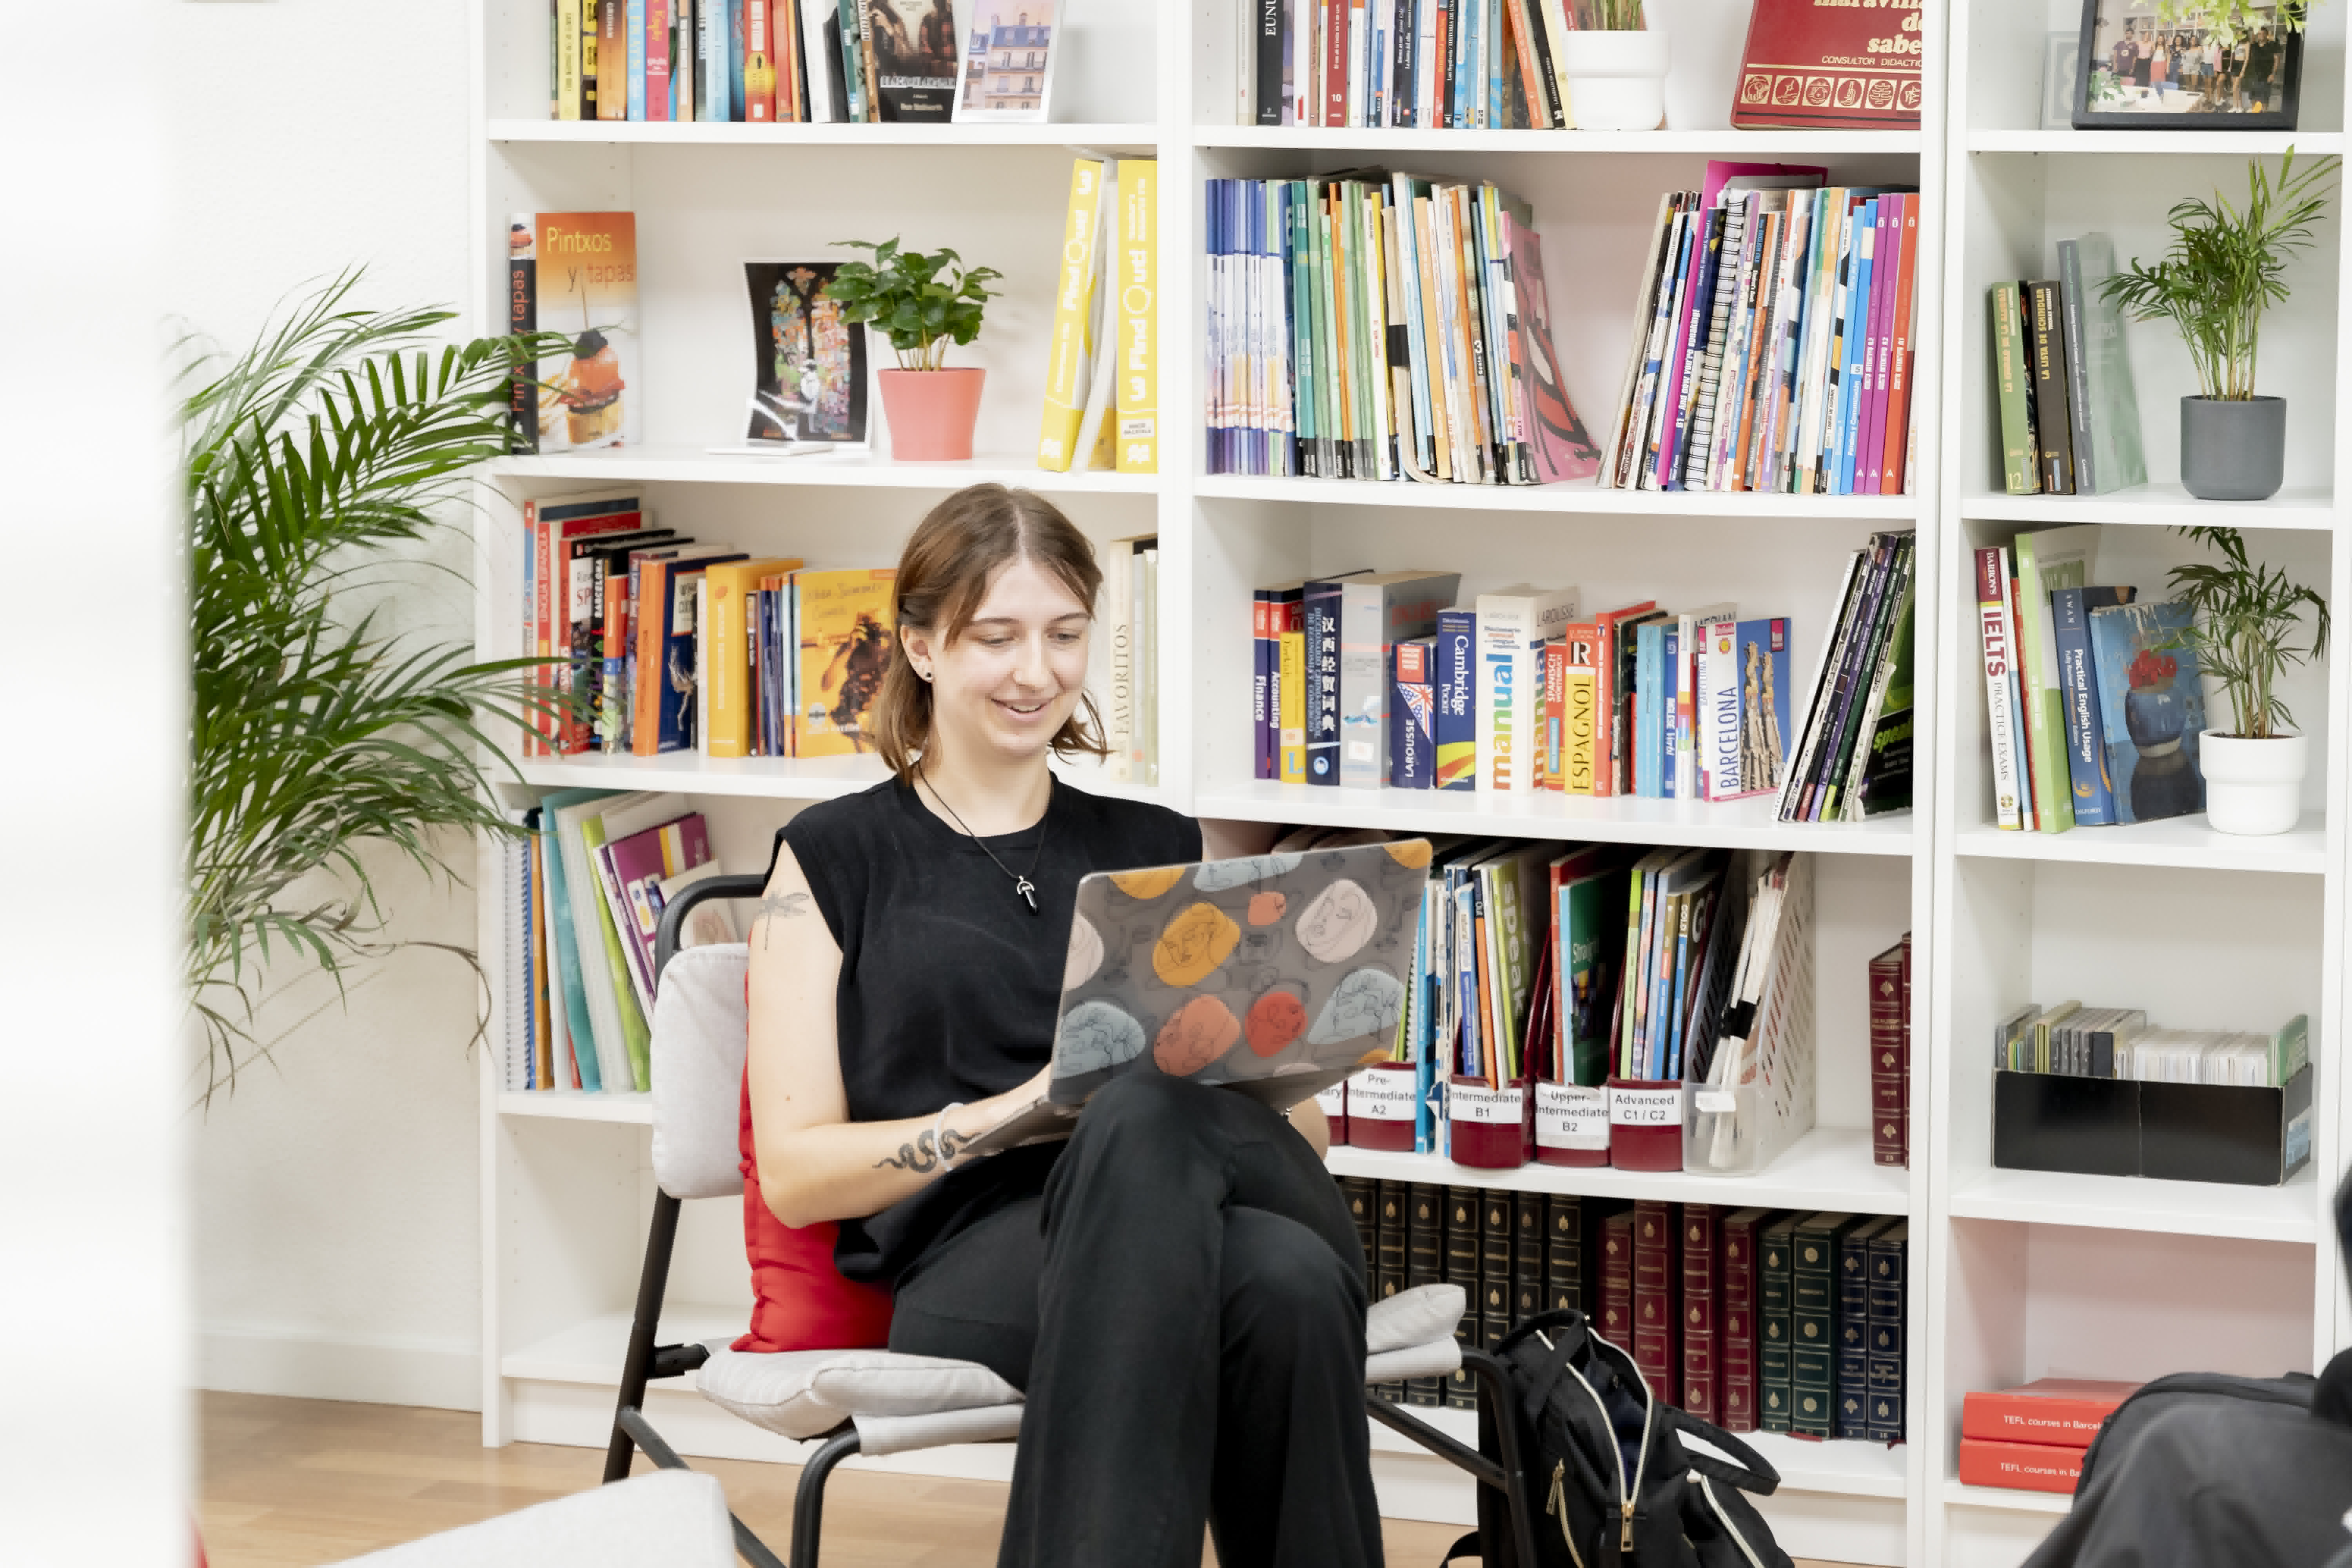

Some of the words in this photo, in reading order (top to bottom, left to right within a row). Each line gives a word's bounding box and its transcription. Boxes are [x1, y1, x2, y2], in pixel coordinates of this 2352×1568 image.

[1867, 34, 1922, 55] sabe
[1821, 56, 1875, 65] CONSULTOR
[546, 227, 612, 253] Pintxos
[568, 267, 577, 292] y
[587, 263, 634, 289] tapas
[512, 269, 530, 321] tapas
[2036, 288, 2047, 331] SCHINDLER
[1686, 309, 1700, 346] speaking!
[2040, 333, 2047, 343] DE
[1683, 348, 1694, 374] you're
[2040, 346, 2049, 367] LISTA
[1681, 376, 1690, 394] now
[2042, 369, 2050, 379] LA
[1678, 394, 1687, 410] And
[2008, 472, 2022, 490] 12
[594, 559, 603, 618] BARCELONA
[2065, 594, 2075, 624] SWAN
[1983, 611, 2006, 677] IELTS
[1113, 624, 1129, 734] FAVORITOS
[1450, 635, 1469, 716] Cambridge
[1547, 653, 1555, 702] SPANISCH
[2073, 649, 2086, 690] Practical
[1254, 675, 1267, 721] Finance
[1270, 671, 1280, 729] Accounting
[1993, 682, 2005, 731] PRACTICE
[2078, 693, 2089, 729] English
[1486, 653, 1513, 790] manual
[1666, 697, 1675, 729] INGLESE
[1572, 677, 1591, 789] ESPAGNOL
[1717, 687, 1740, 789] BARCELONA
[2081, 731, 2092, 763] Usage
[1405, 719, 1415, 778] LAROUSSE
[1996, 735, 2008, 781] EXAMS
[1679, 904, 1688, 932] GOLD
[1367, 1074, 1391, 1085] Pre-
[1371, 1105, 1387, 1115] A2
[1551, 1091, 1591, 1103] Upper-
[1615, 1094, 1675, 1104] Advanced
[1475, 1107, 1491, 1118] B1
[1562, 1122, 1578, 1132] B2
[1624, 1110, 1638, 1120] C1
[1649, 1111, 1666, 1120] C2
[2003, 1415, 2026, 1425] TEFL
[2028, 1419, 2062, 1428] courses
[2063, 1418, 2071, 1428] in
[2000, 1462, 2023, 1472] TEFL
[2024, 1466, 2058, 1475] courses
[2059, 1466, 2068, 1476] in
